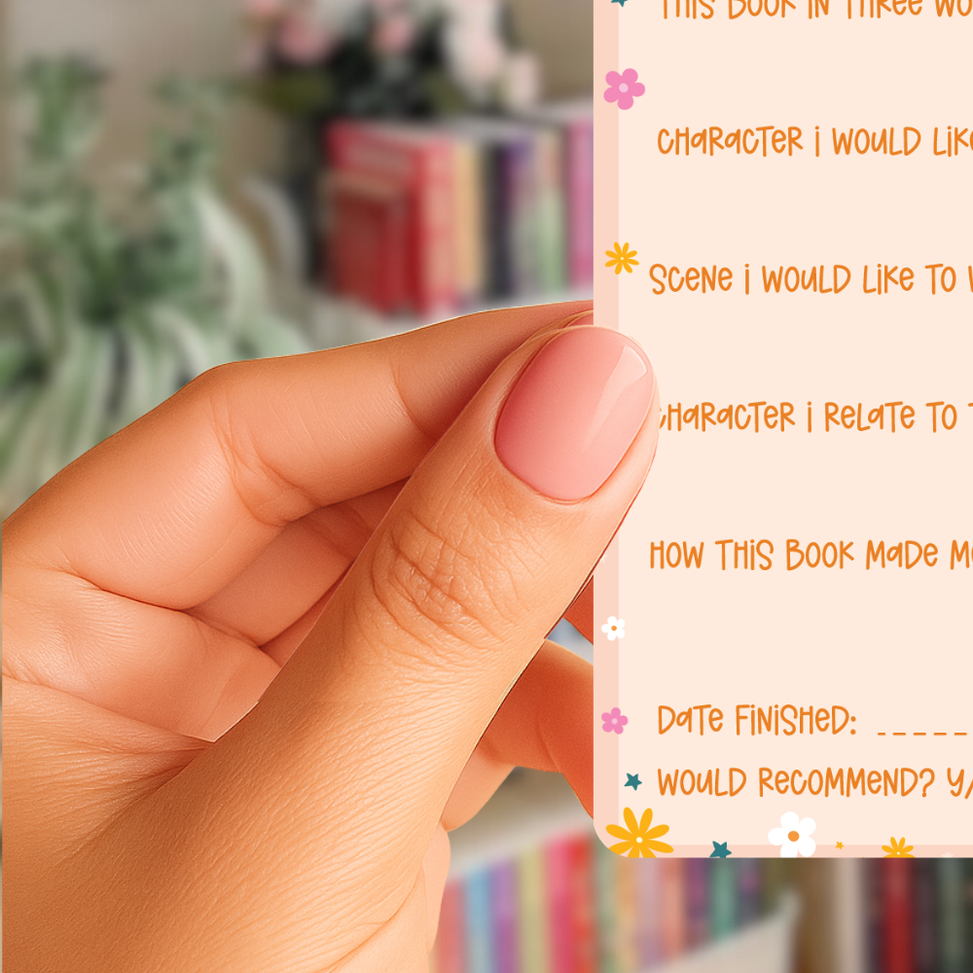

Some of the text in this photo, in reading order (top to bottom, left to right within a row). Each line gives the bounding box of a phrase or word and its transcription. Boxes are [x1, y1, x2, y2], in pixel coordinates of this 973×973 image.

[924, 263, 957, 296] TO
[925, 401, 958, 434] TO
[650, 540, 705, 570] HOW
[786, 538, 855, 571] BOOK
